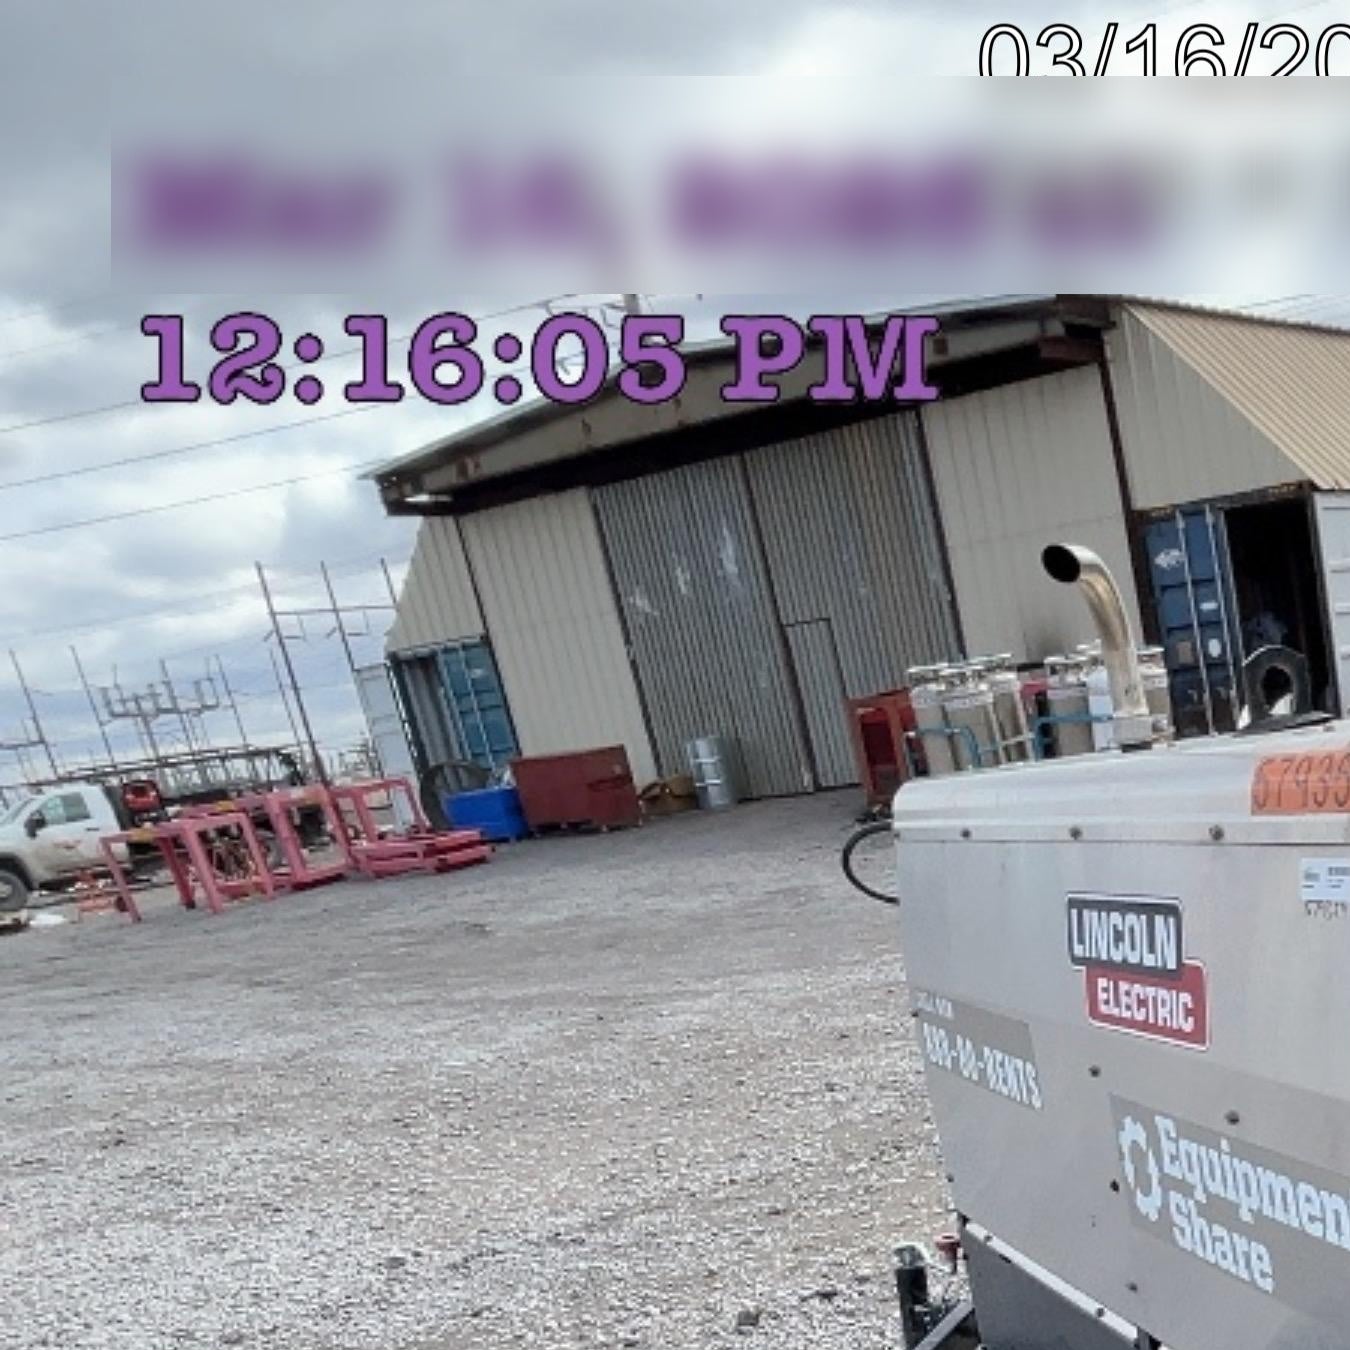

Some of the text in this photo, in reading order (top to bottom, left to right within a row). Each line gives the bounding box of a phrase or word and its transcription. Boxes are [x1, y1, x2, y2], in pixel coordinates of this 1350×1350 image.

[1070, 907, 1178, 970] LINCOLN
[1097, 976, 1196, 1033] ELECTRIC
[1169, 1190, 1275, 1294] Share
